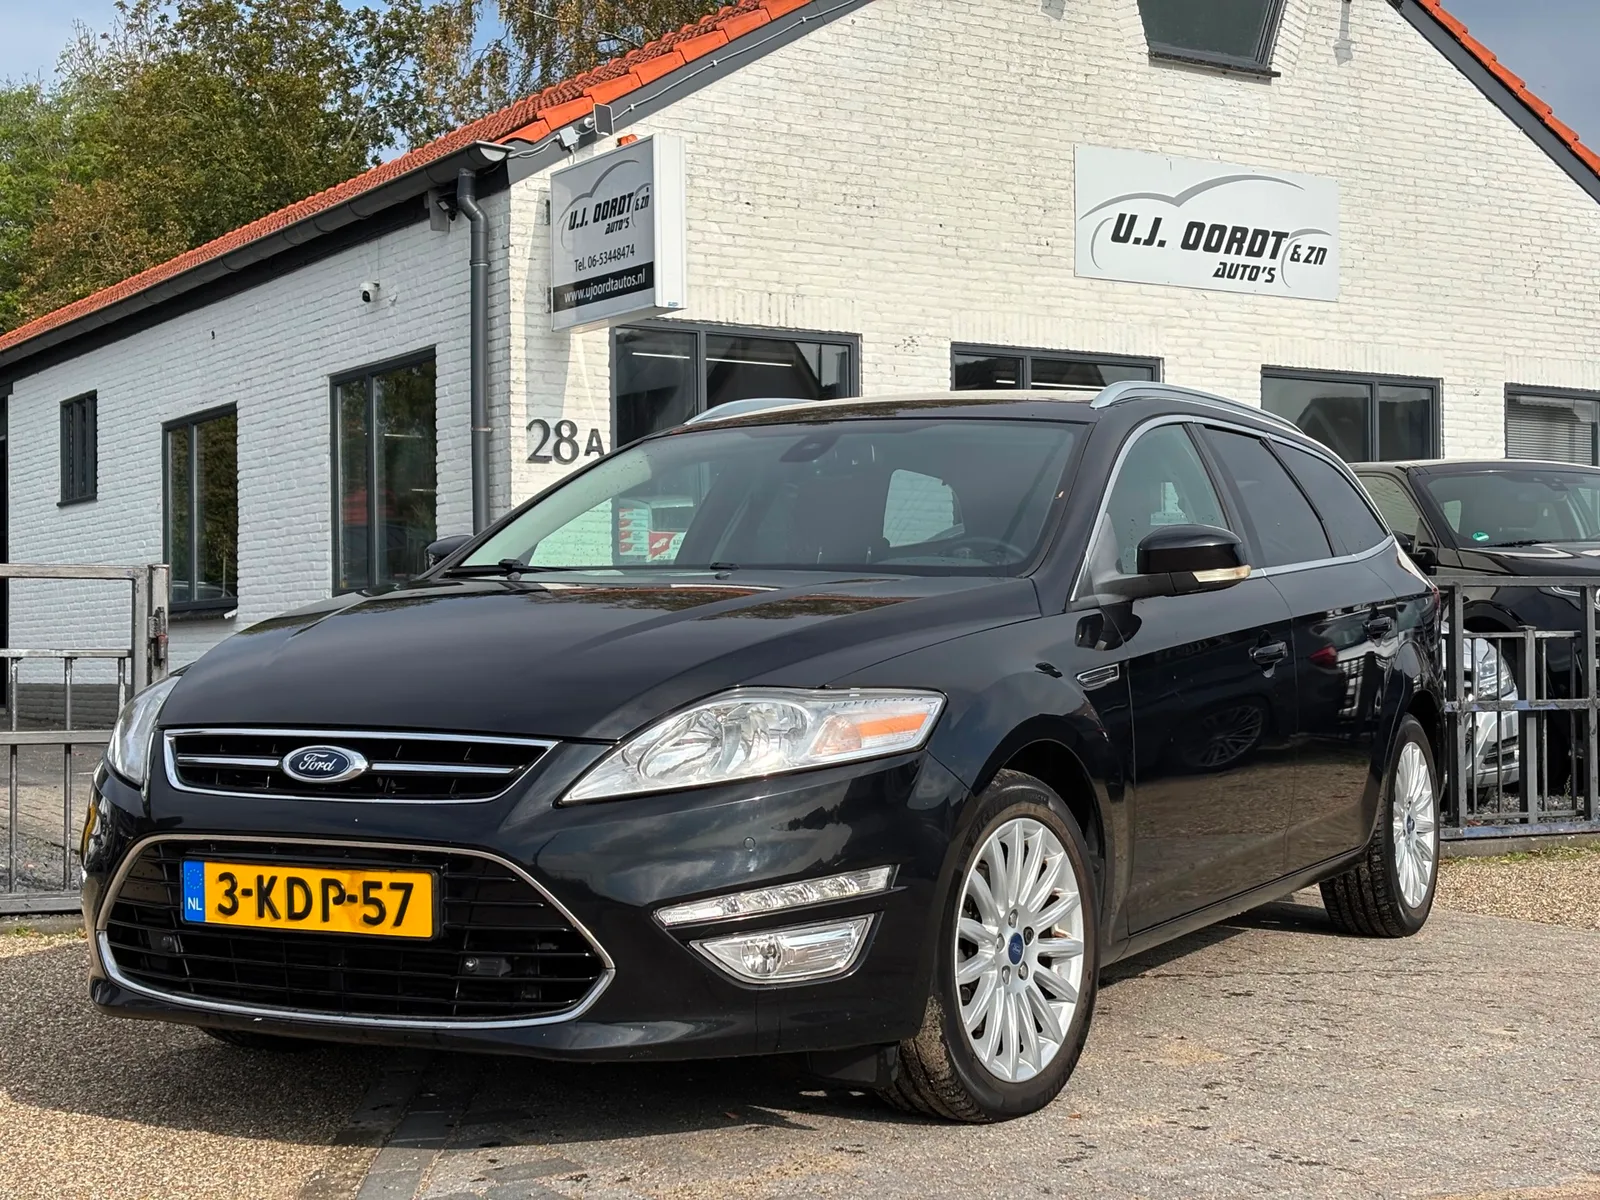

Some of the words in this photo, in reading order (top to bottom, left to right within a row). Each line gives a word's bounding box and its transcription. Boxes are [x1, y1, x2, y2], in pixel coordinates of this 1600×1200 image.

[568, 207, 588, 231] U.J.
[593, 191, 635, 223] OORDT
[1110, 213, 1167, 248] U.J.
[1180, 221, 1290, 260] OORDT
[574, 257, 587, 272] Tel.
[587, 243, 635, 268] 06-53448474
[564, 268, 646, 303] www.ujoordtautos.nl
[298, 752, 337, 772] Ford
[187, 897, 203, 911] NL
[217, 871, 414, 927] 3-KDP-57
